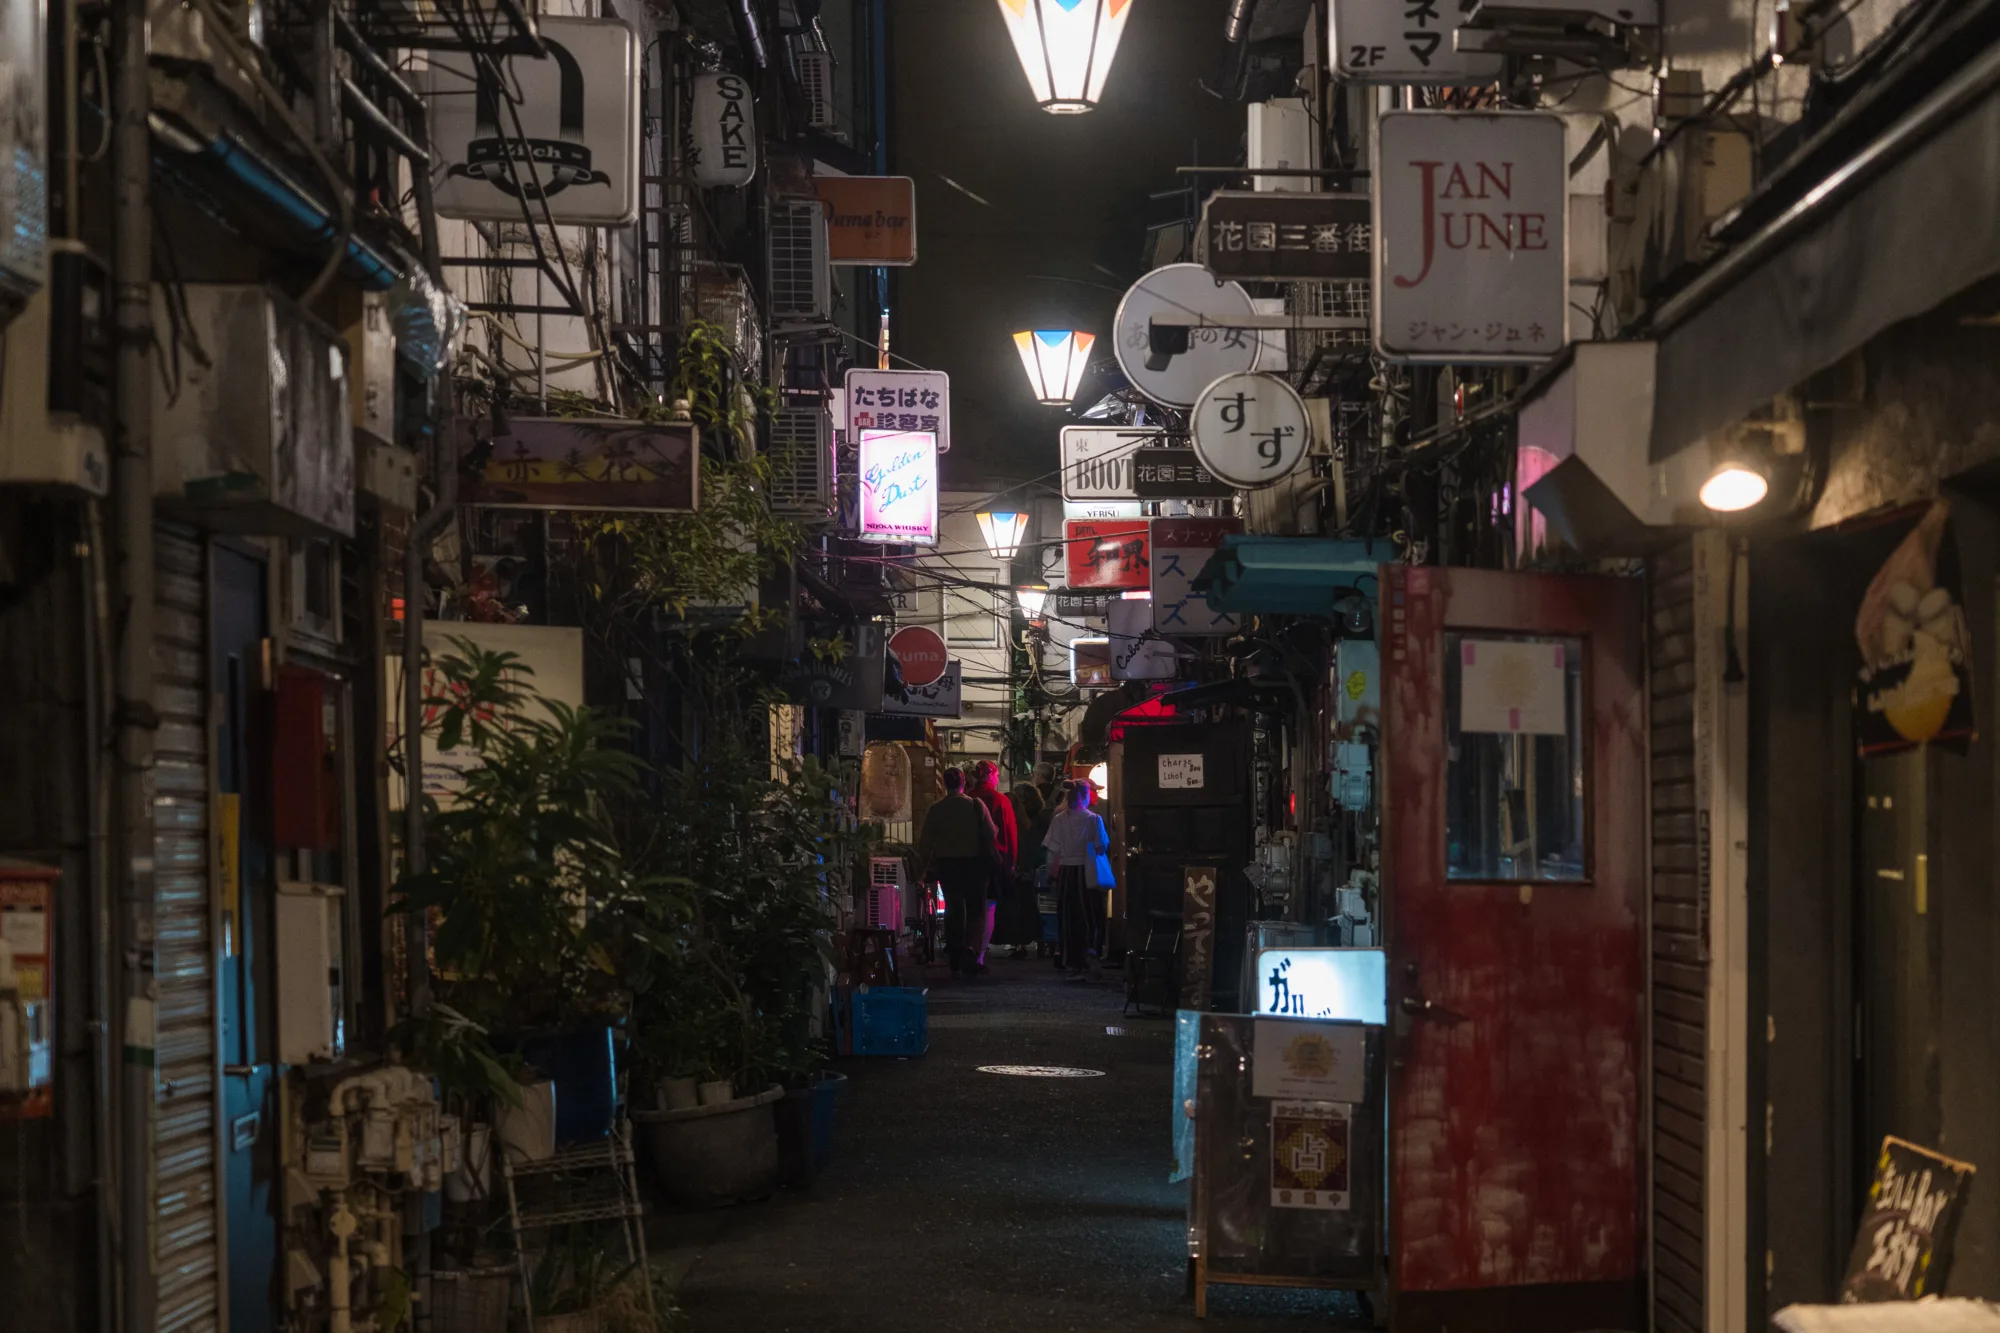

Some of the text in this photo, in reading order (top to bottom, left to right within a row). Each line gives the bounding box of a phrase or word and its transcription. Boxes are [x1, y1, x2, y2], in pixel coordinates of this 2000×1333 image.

[1350, 46, 1386, 67] 2F
[717, 77, 748, 169] SAKE
[1212, 221, 1371, 253] 花園三番街
[1409, 322, 1545, 342] ジャン・ジュネ
[855, 386, 940, 409] たちばな
[1213, 392, 1295, 470] すず
[879, 475, 928, 513] Dust
[895, 524, 929, 532] WHISKY
